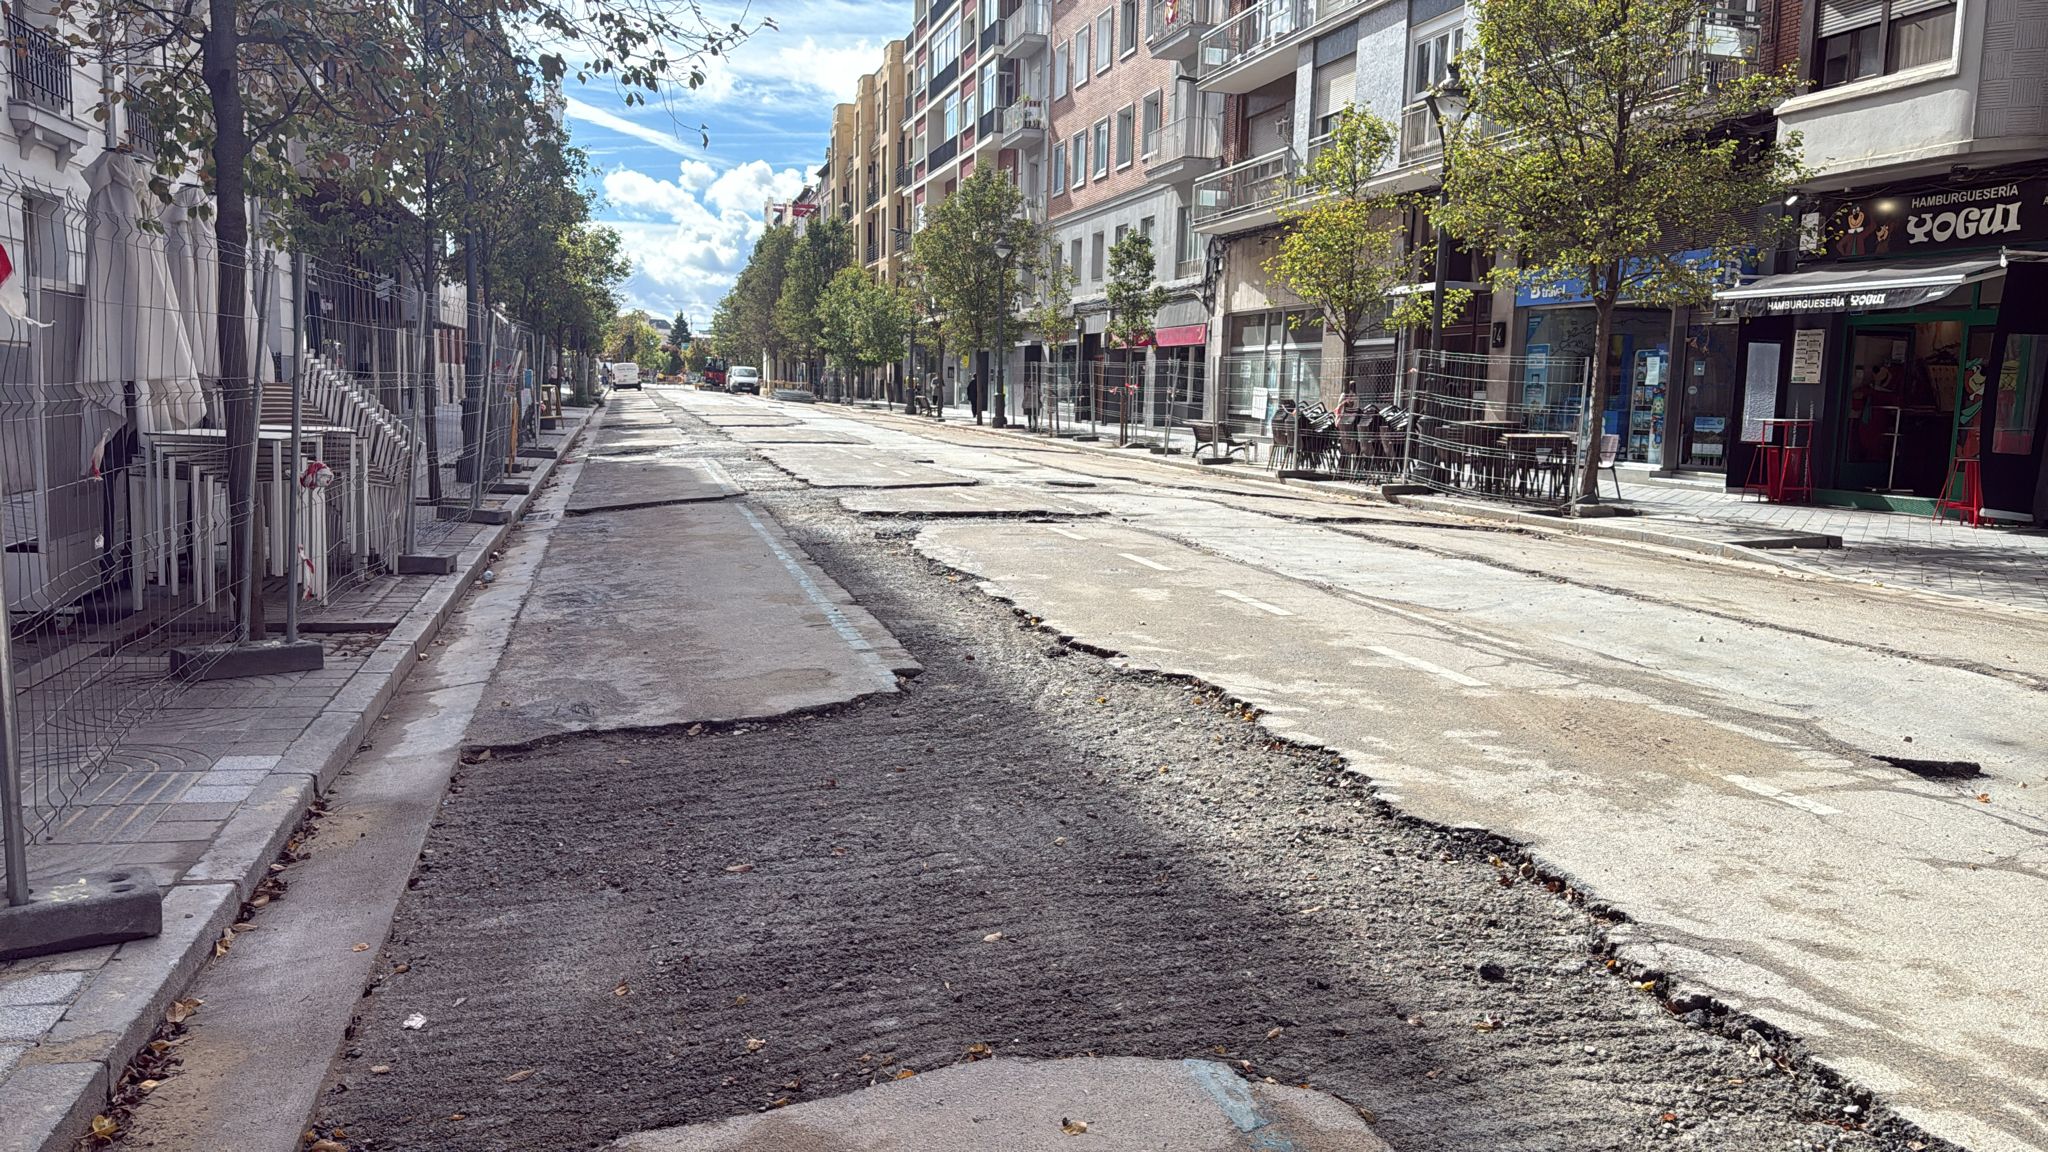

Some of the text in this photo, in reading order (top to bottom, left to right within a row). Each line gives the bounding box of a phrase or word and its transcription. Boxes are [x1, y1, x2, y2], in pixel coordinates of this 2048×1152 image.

[1911, 184, 2019, 209] HAMBURGUESERÍA
[1906, 201, 2022, 244] YOGUI
[1767, 295, 1845, 311] HAMBURGUESERÍA
